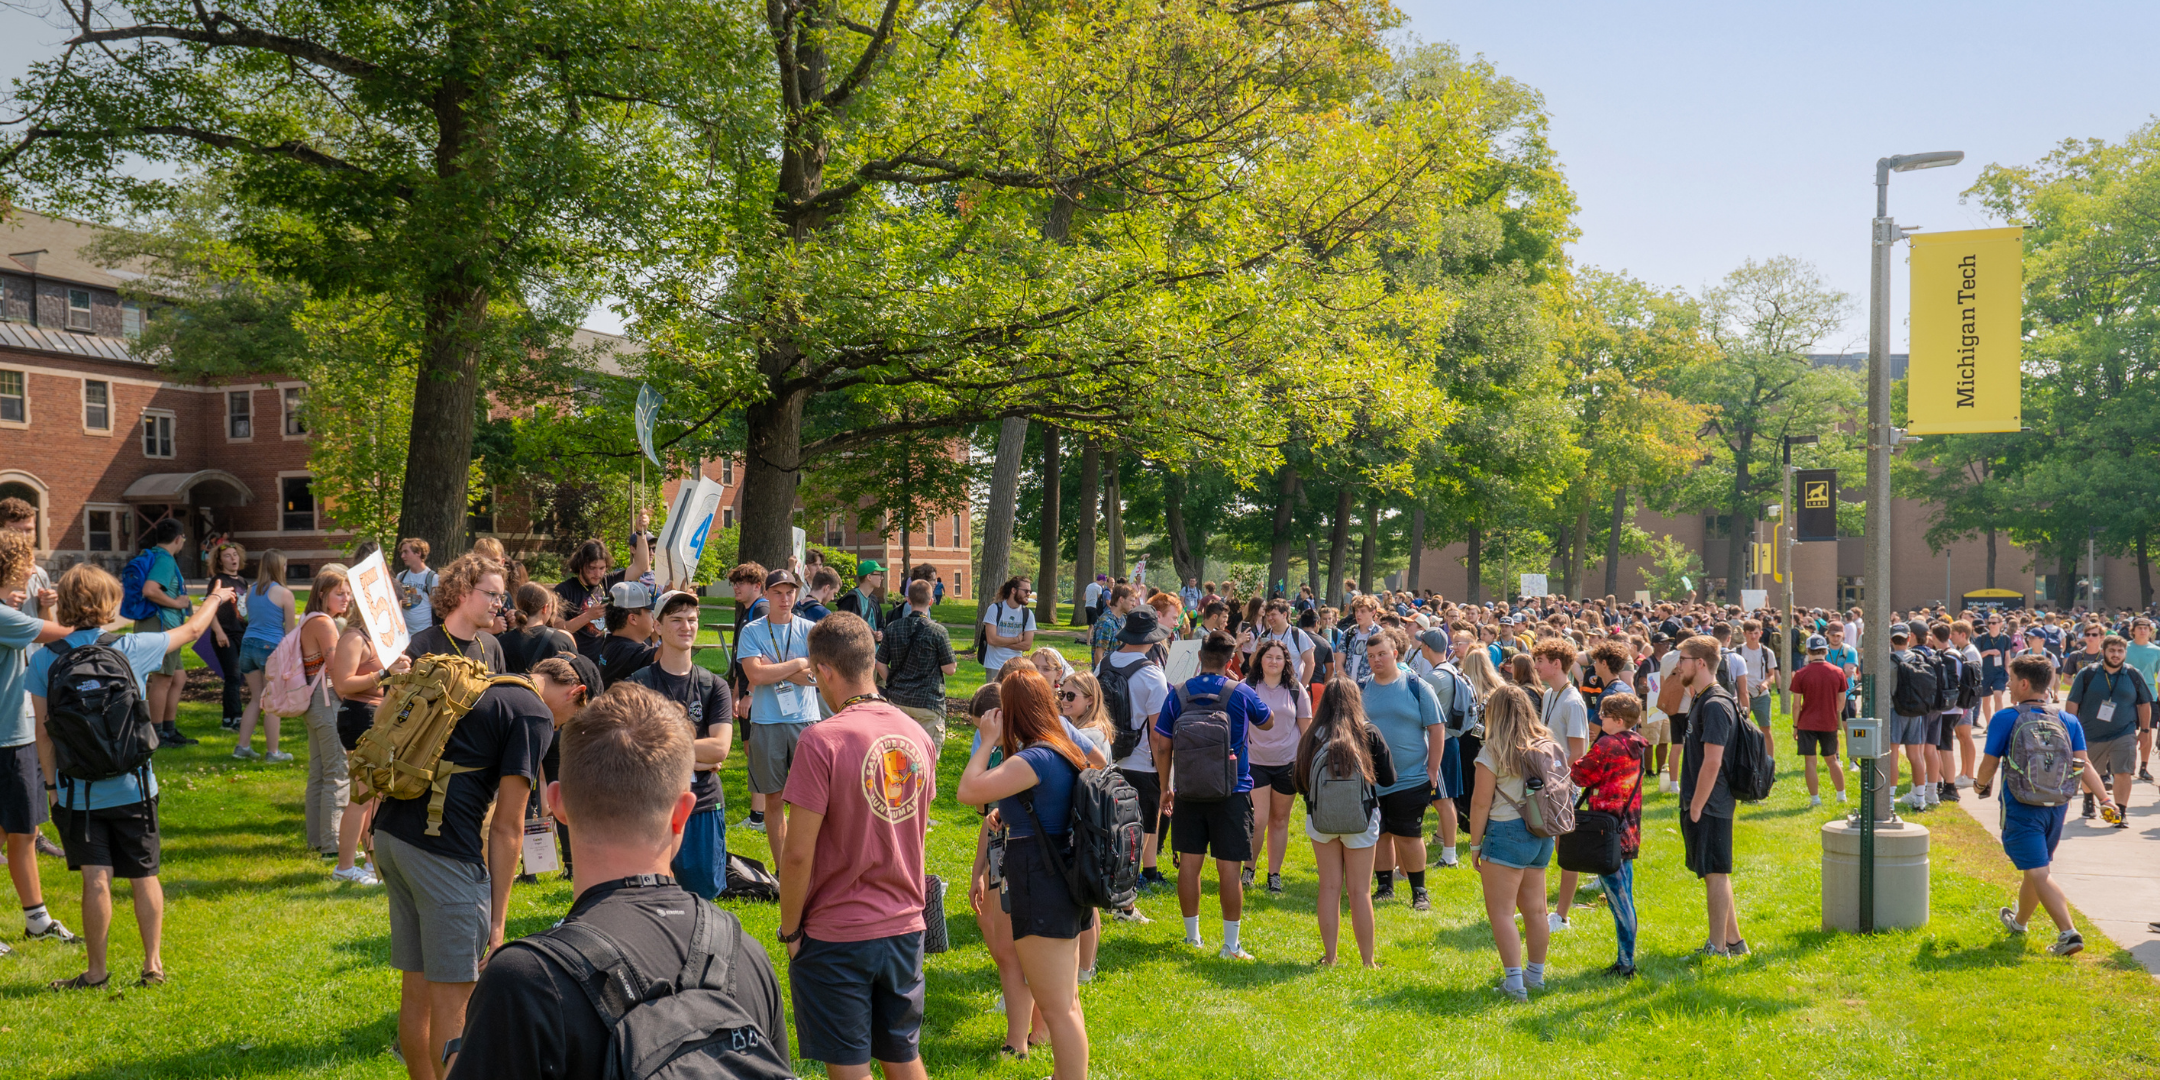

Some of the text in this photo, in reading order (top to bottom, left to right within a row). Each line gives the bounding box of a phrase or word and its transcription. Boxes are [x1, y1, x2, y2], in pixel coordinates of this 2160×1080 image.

[1956, 254, 1979, 409] Michigan Tech
[689, 513, 714, 560] 4
[866, 747, 881, 776] SAVE
[879, 739, 897, 752] THE
